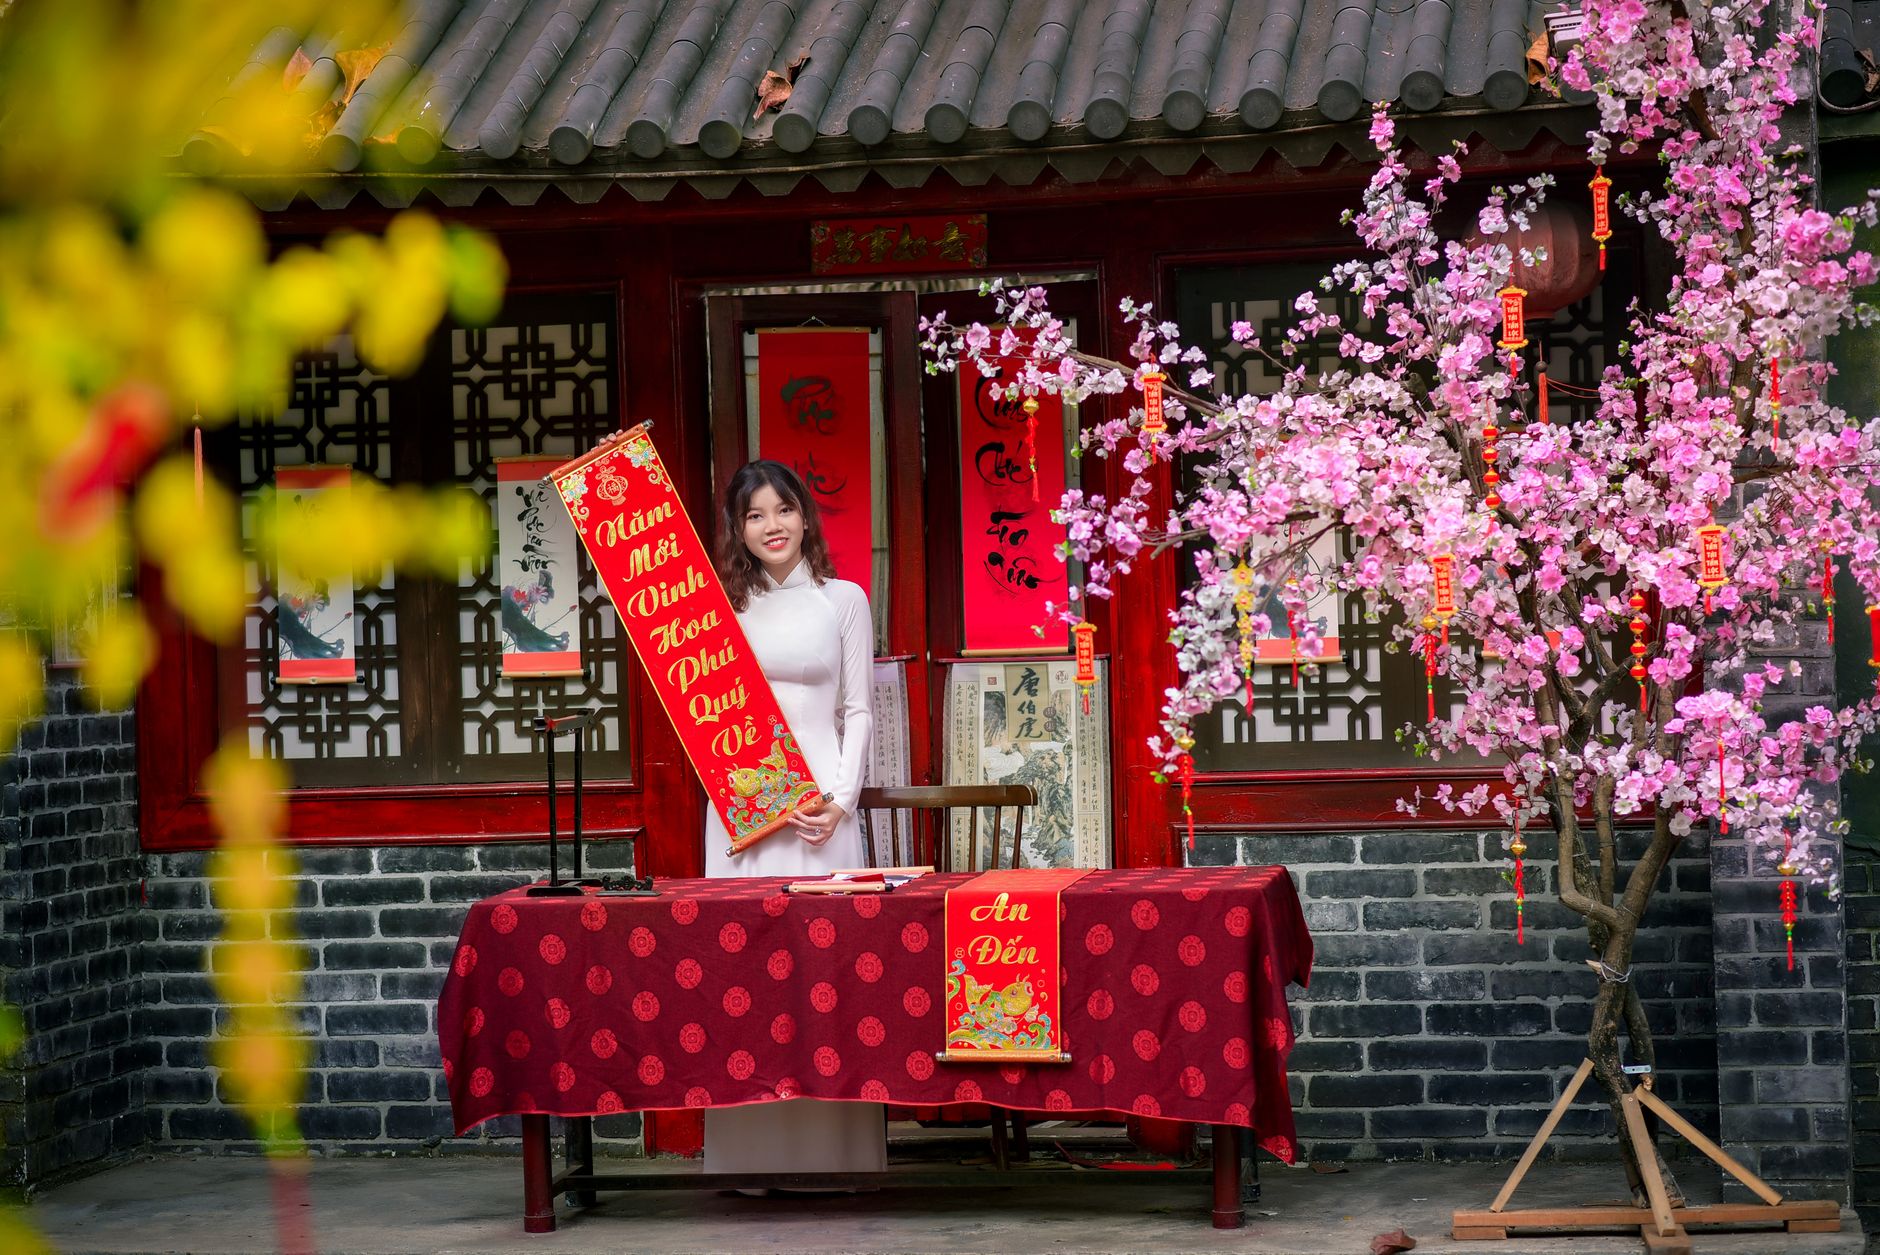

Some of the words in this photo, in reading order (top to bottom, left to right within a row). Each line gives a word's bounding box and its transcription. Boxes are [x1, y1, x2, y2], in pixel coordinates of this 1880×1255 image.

[595, 501, 676, 548] Năm
[622, 532, 684, 583] Mới
[627, 565, 709, 618] Vinh
[649, 609, 722, 655] Hoa
[667, 637, 738, 695] Phú
[689, 676, 750, 726] Quý
[1012, 666, 1043, 739] 唐伯虎
[711, 714, 763, 758] Về
[970, 892, 1031, 922] An
[968, 935, 1039, 965] Đến
